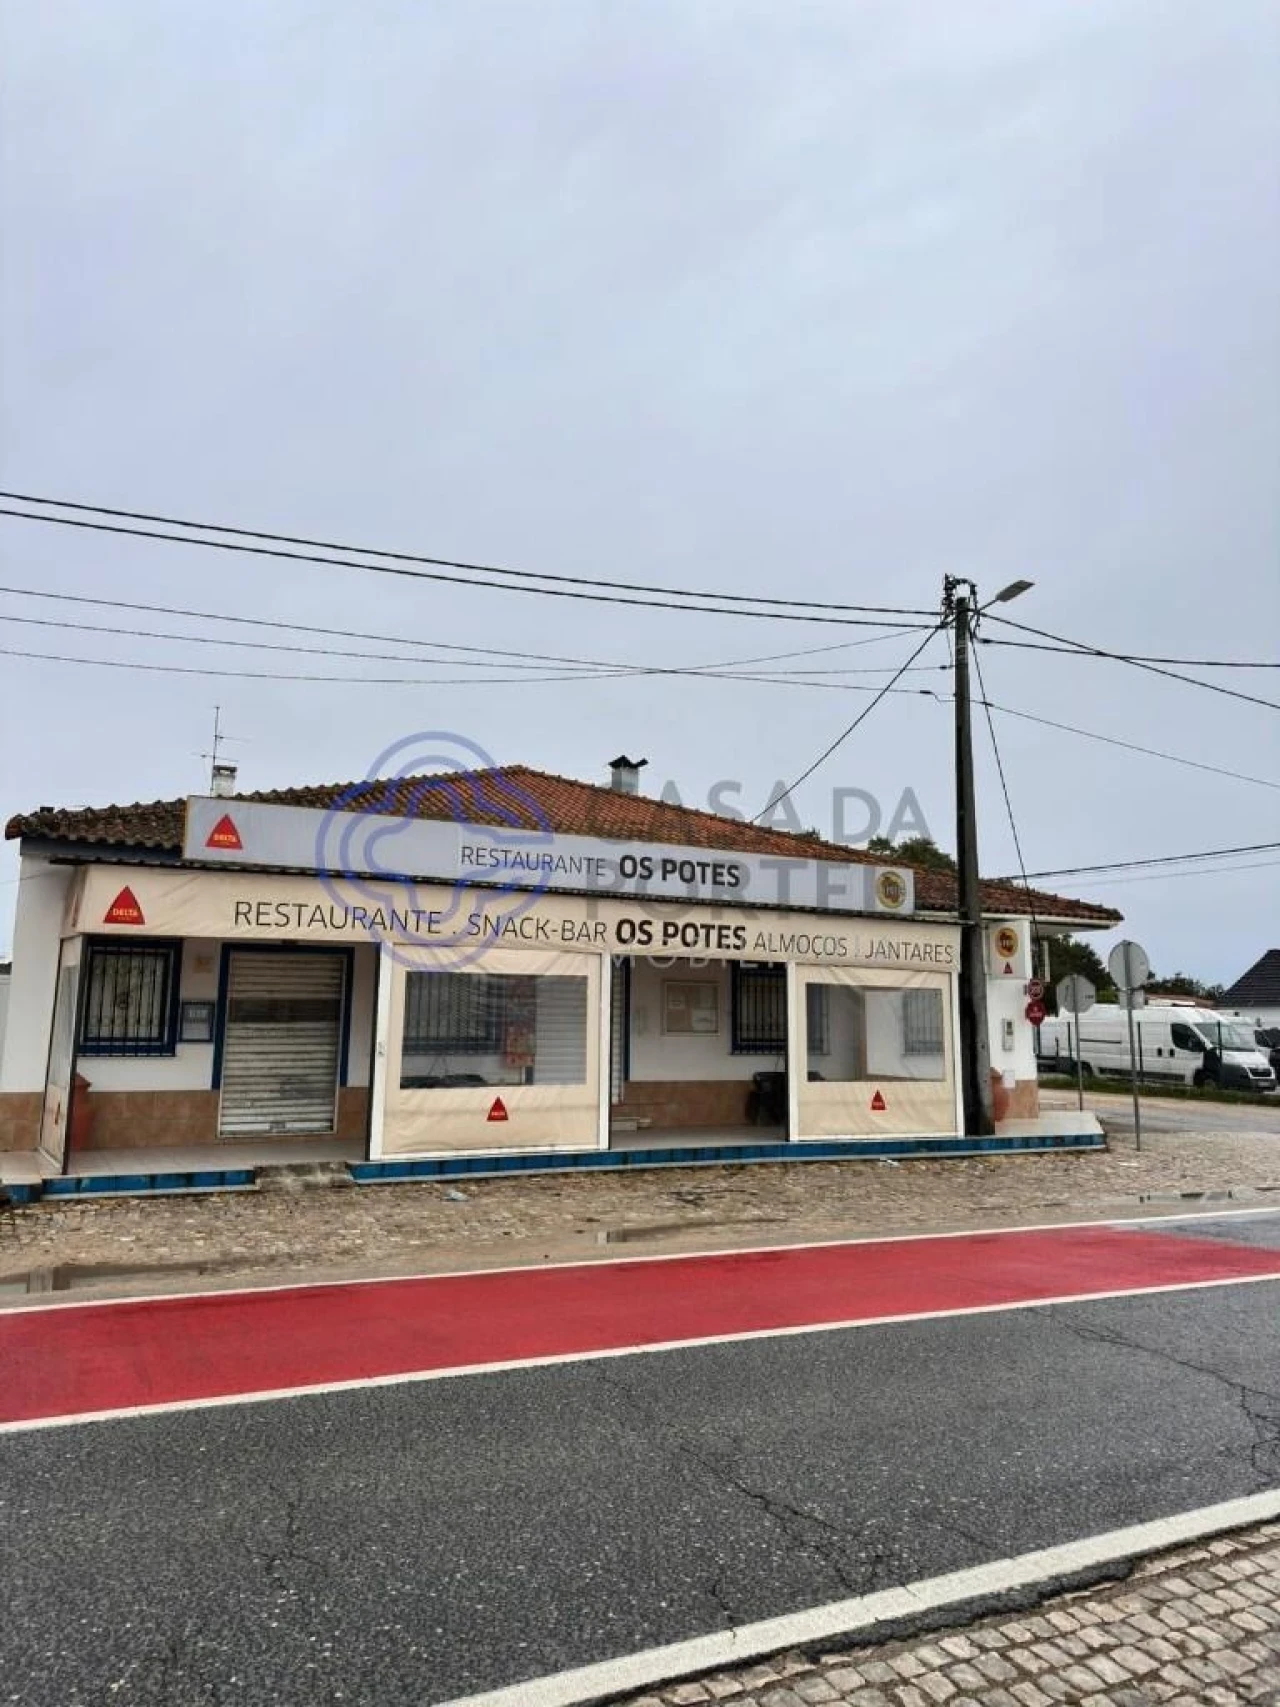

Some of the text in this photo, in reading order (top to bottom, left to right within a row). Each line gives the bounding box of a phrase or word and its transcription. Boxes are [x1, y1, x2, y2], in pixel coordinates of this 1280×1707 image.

[461, 846, 741, 888] RESTAURANTE OS POTES
[112, 908, 139, 917] DELTA
[234, 901, 443, 934] RESTAURANTE
[467, 913, 608, 943] SNACK-BAR
[615, 918, 653, 946] OS
[662, 921, 747, 951] POTES
[753, 932, 847, 959] ALMOÇOS
[864, 939, 954, 964] JANTARES
